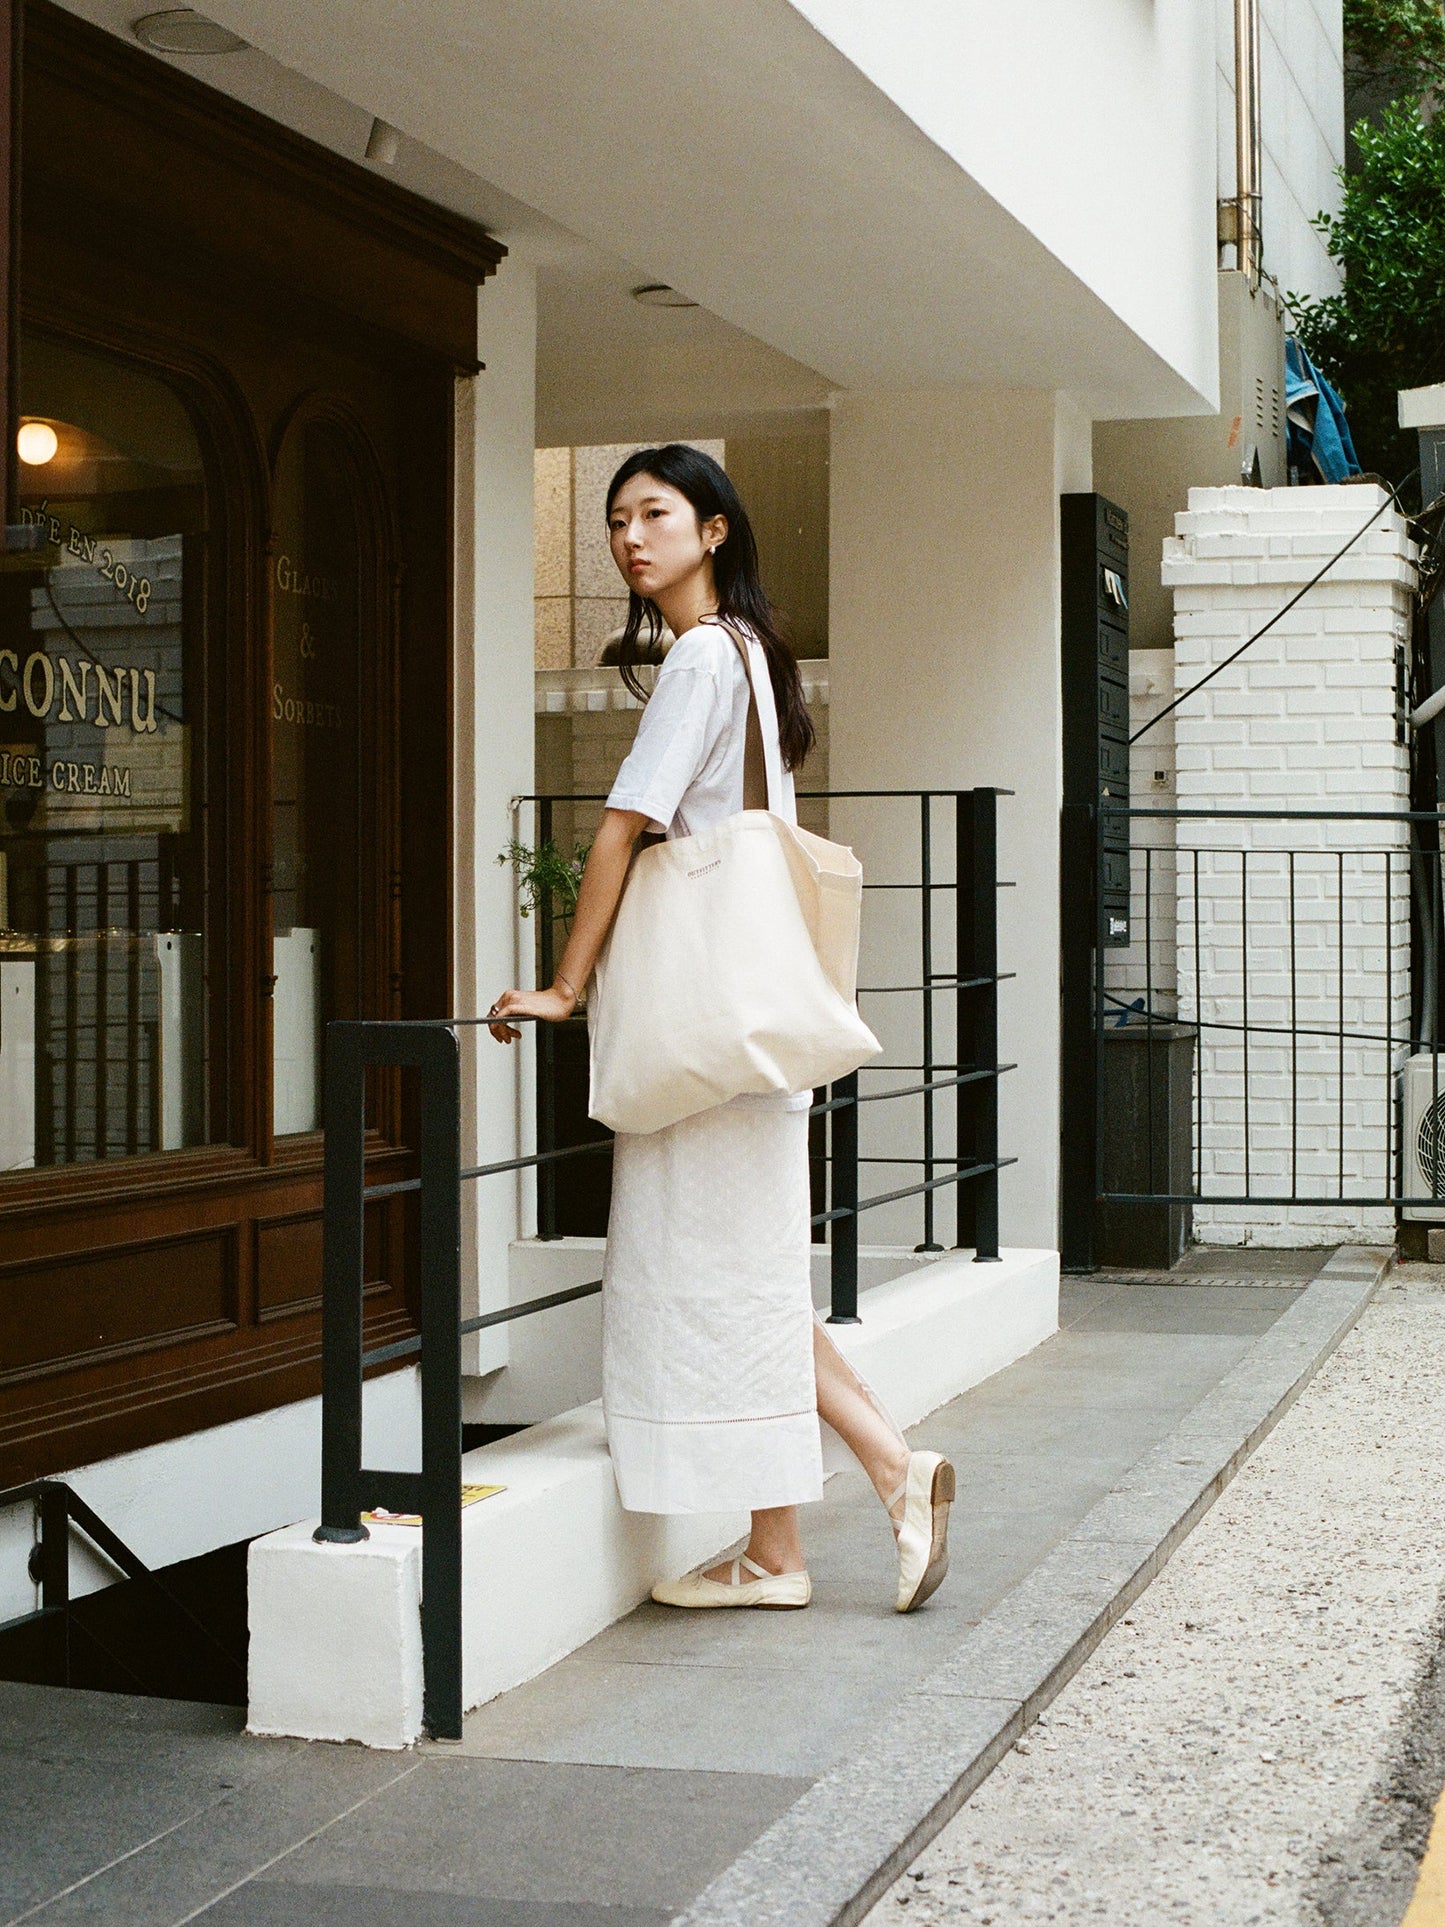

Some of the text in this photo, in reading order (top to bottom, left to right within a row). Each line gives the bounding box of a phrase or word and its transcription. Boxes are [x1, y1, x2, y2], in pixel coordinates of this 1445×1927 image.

[68, 527, 97, 564] EN
[101, 551, 151, 614] 2018
[300, 622, 317, 659] &
[1, 752, 131, 797] ICE CREAM
